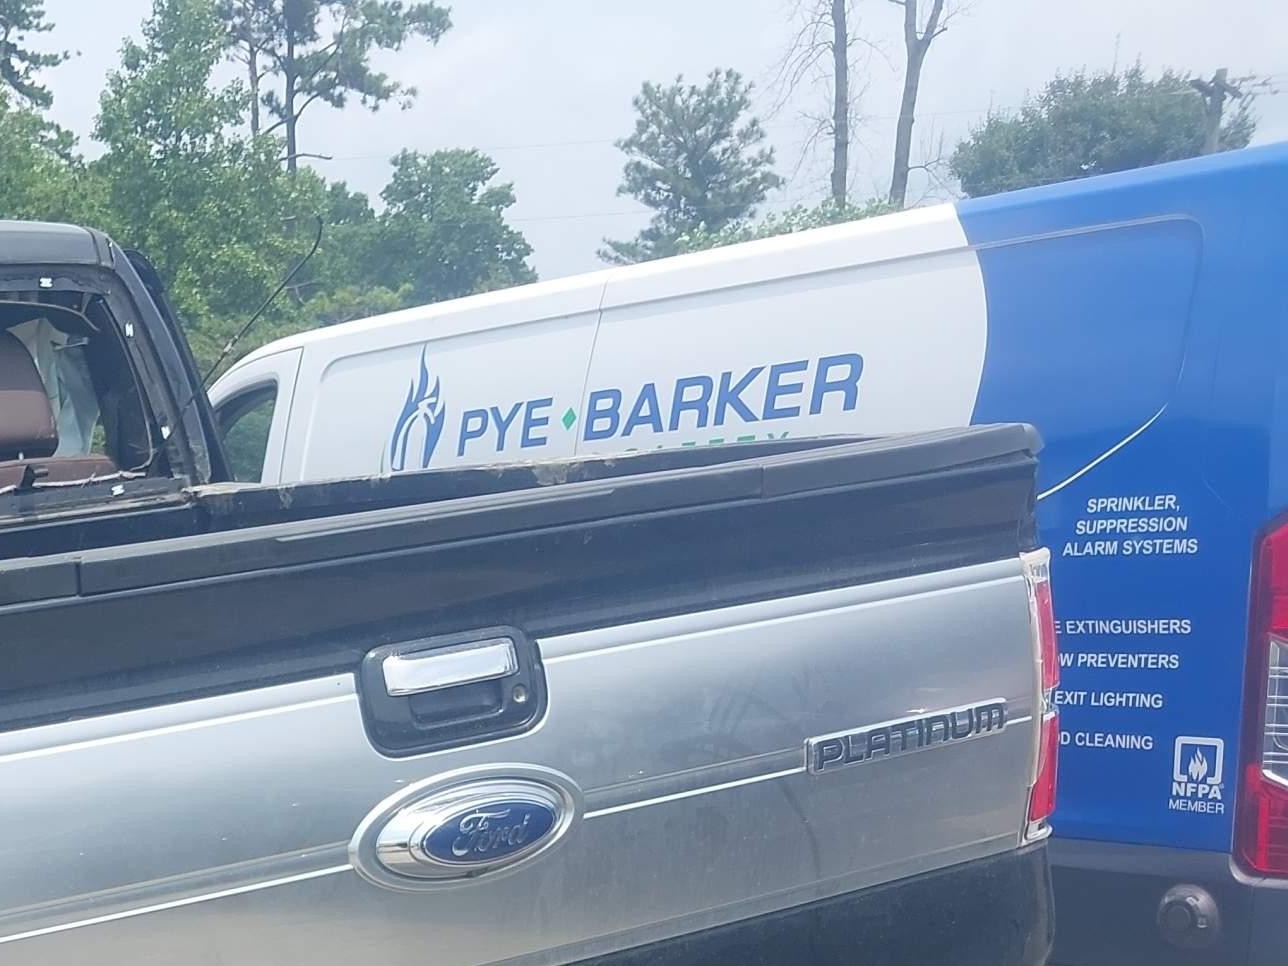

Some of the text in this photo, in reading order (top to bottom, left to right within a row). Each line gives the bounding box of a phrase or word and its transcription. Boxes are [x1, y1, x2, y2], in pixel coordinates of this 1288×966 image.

[456, 353, 864, 456] PYE BARKER
[1086, 494, 1180, 513] SPRINKLER,
[1075, 516, 1188, 535] SUPPRESSION
[1063, 538, 1198, 557] ALARM SYSTEMS
[1066, 619, 1192, 634] EXTINGUISHERS
[1077, 653, 1180, 669] PREVENTERS
[1054, 690, 1163, 709] EXIT LIGHTING
[813, 702, 1005, 771] PLATINUM
[1075, 732, 1154, 750] CLEANING
[1172, 781, 1222, 800] NFPA
[1168, 798, 1225, 814] MEMBER
[451, 808, 531, 857] Ford
